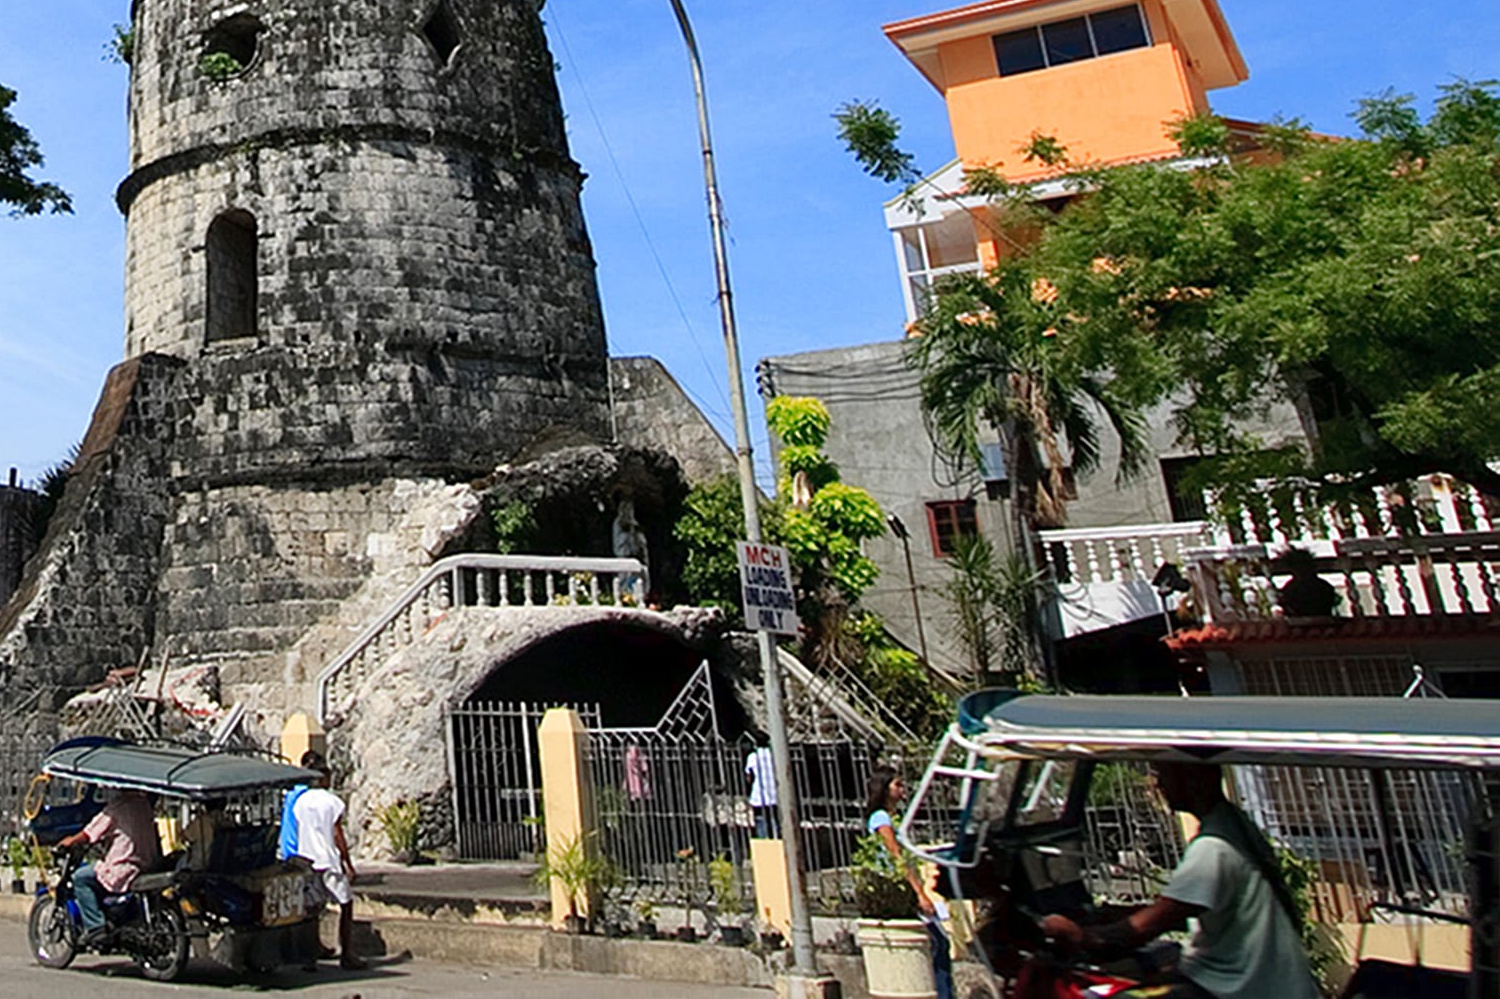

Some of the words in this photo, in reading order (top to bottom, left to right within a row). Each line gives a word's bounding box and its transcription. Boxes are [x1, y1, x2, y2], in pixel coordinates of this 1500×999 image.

[745, 544, 782, 568] MCH
[745, 565, 787, 589] LOADING
[759, 609, 783, 630] ONLY
